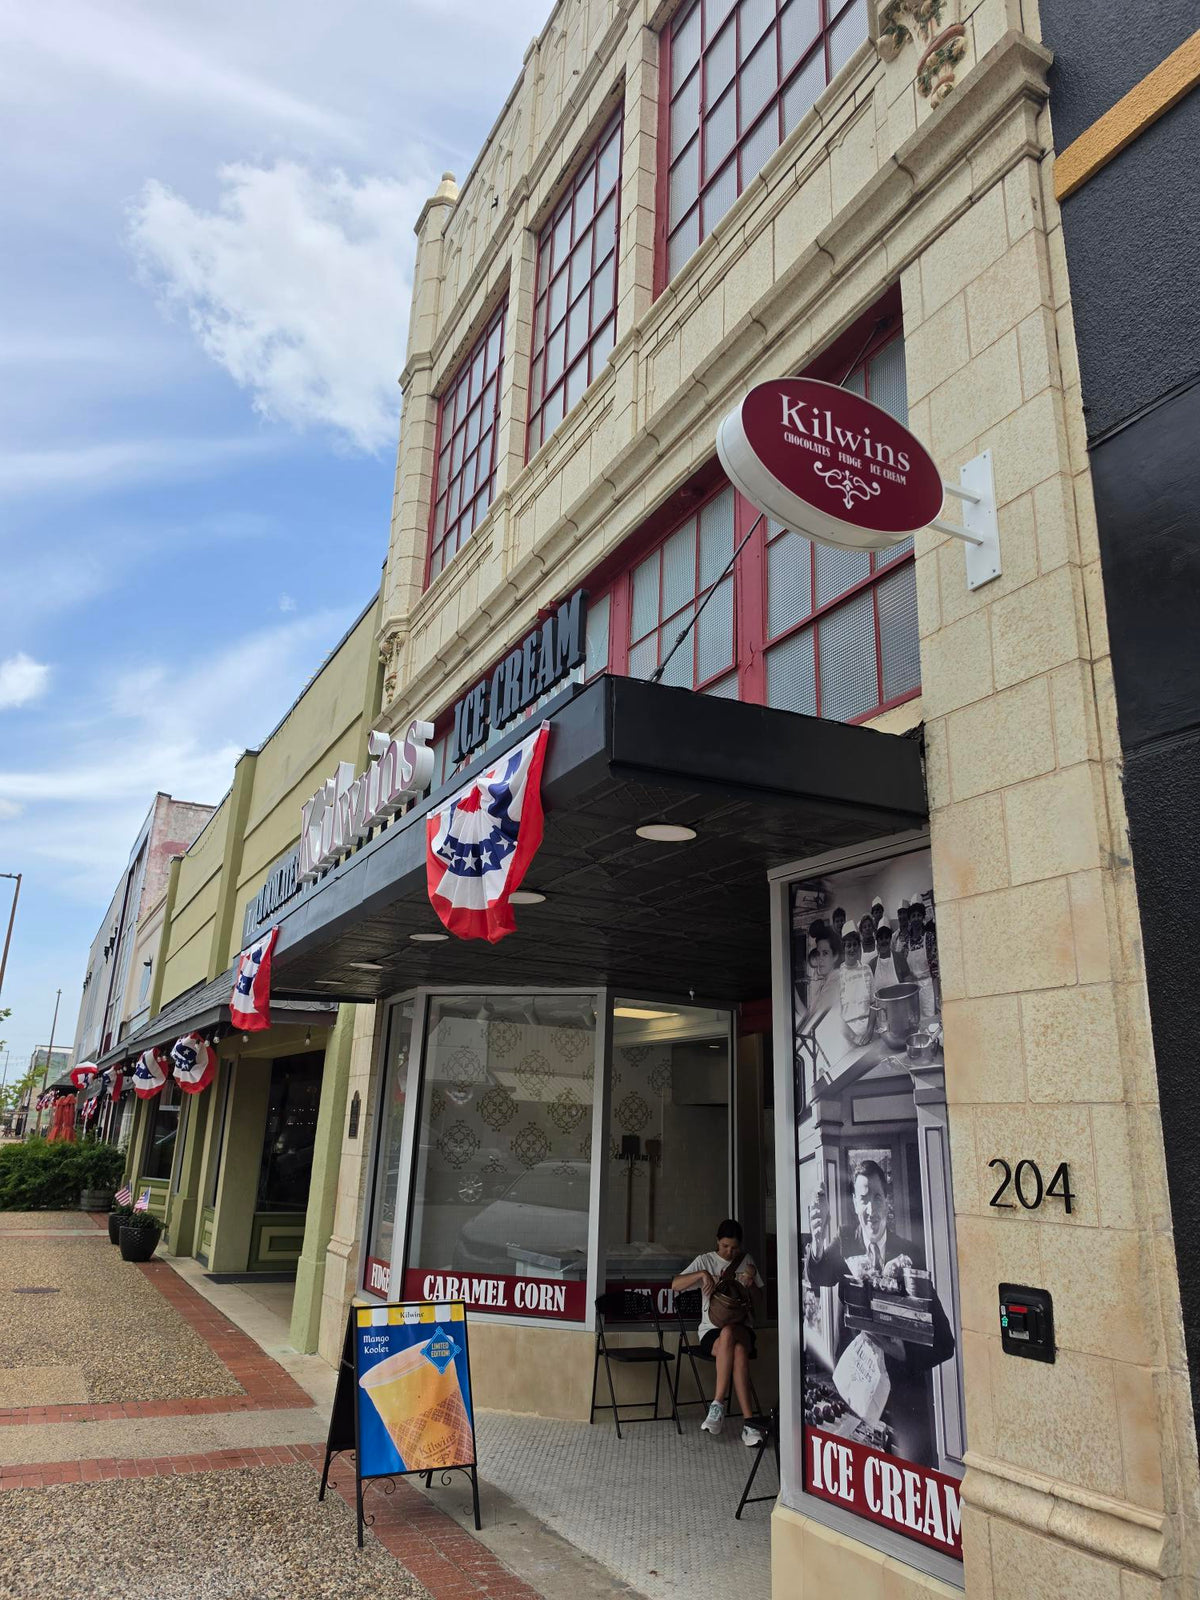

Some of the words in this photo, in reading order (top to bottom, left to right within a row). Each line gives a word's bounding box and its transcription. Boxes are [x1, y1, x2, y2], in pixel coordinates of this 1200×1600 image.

[779, 393, 910, 472] Kilwins
[784, 431, 831, 458] CHOCOLATES
[838, 451, 863, 469] FUDGE
[870, 463, 881, 477] ICE
[883, 467, 907, 486] CREAM
[452, 679, 490, 764] ICE
[489, 588, 588, 731] CREAM
[988, 1158, 1076, 1214] 204
[400, 1311, 425, 1319] Kilwins
[423, 1275, 507, 1306] CARAMEL
[514, 1282, 566, 1312] CORN
[363, 1335, 390, 1345] Mango
[364, 1344, 389, 1354] Kooler
[431, 1342, 449, 1350] LIMITED
[811, 1435, 855, 1502] ICE
